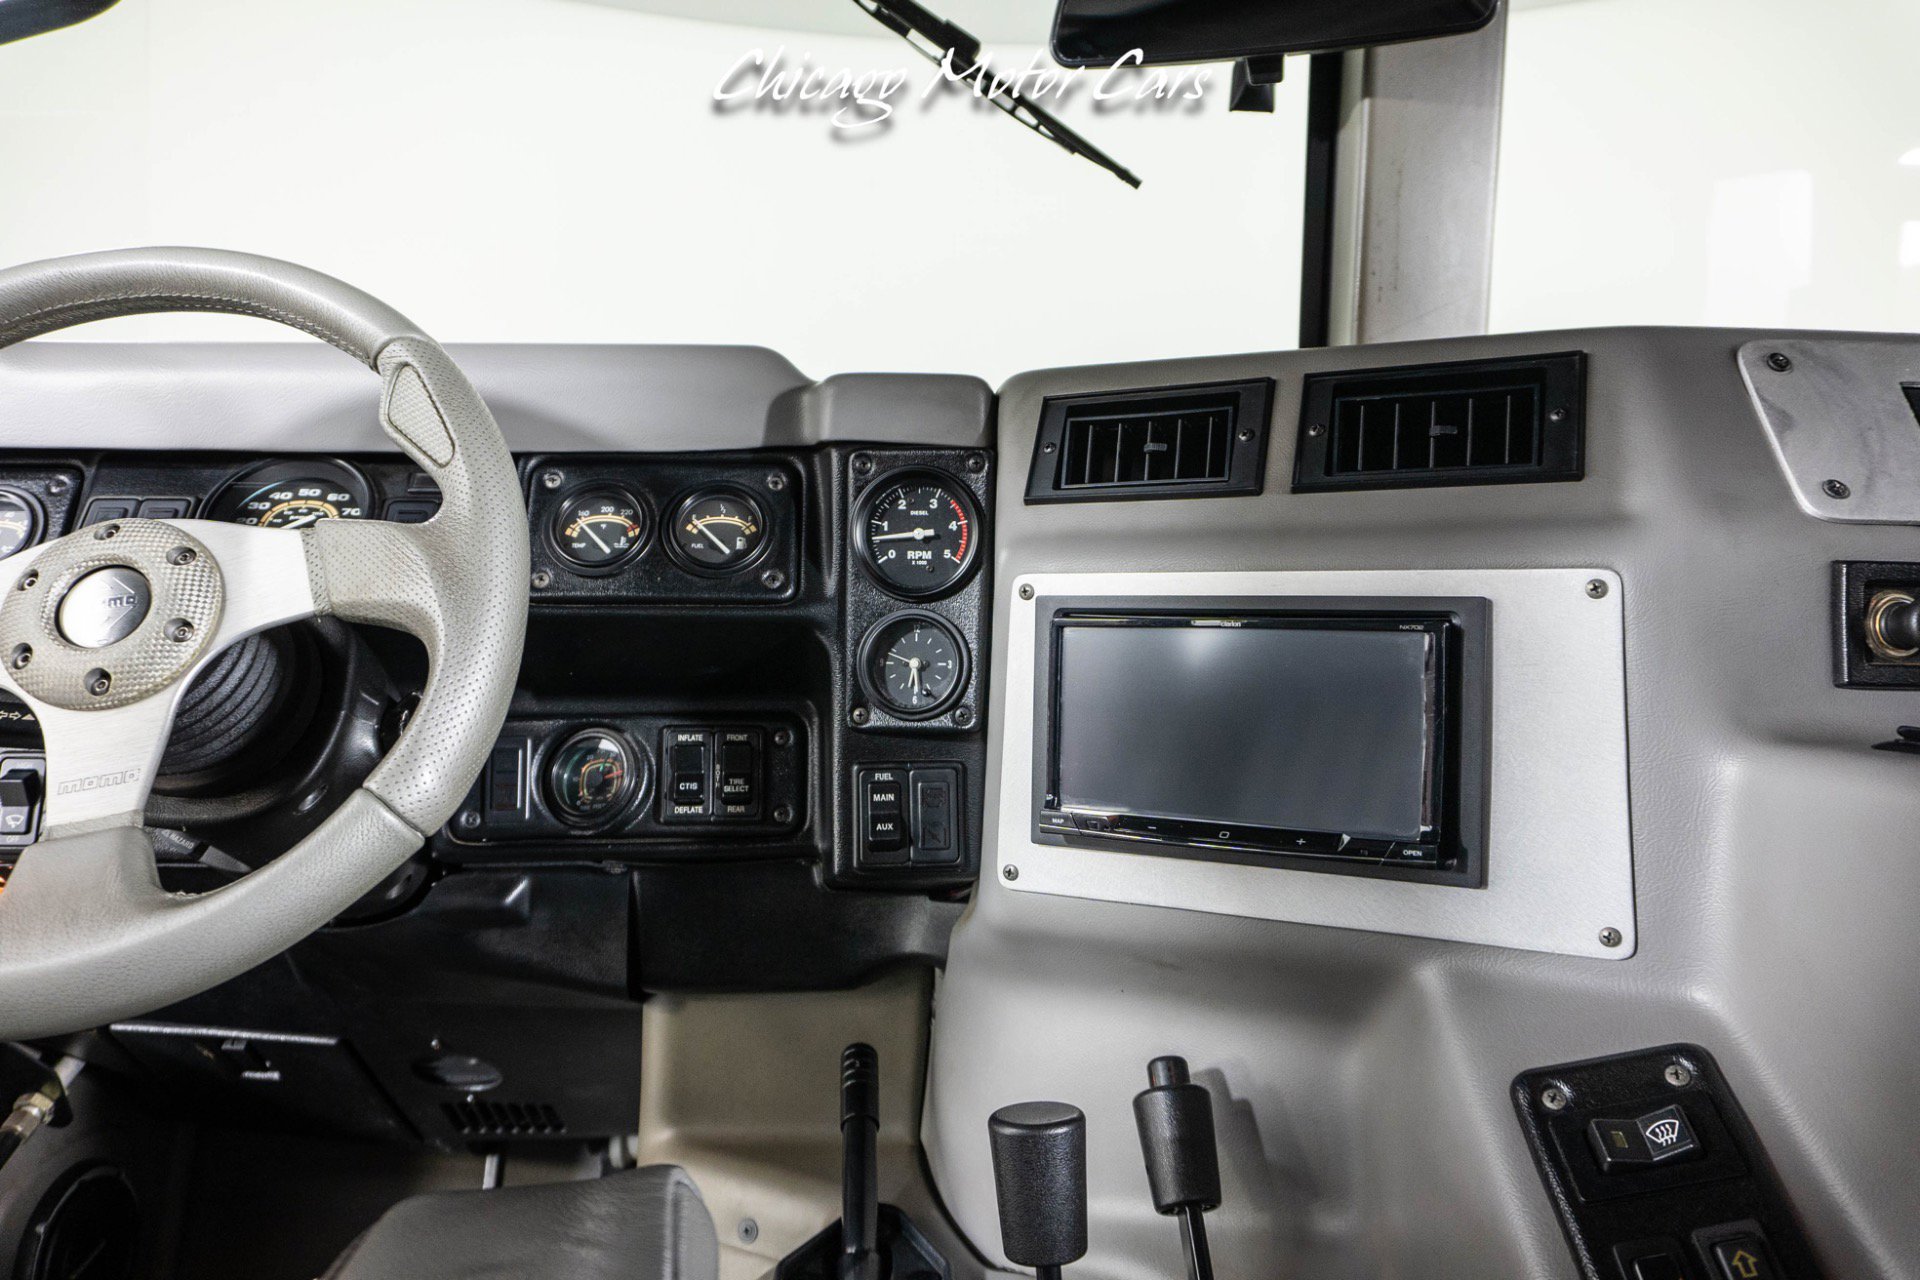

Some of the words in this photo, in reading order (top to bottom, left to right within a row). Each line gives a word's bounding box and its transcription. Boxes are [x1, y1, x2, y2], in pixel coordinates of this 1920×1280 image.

[269, 491, 293, 500] 40
[327, 493, 350, 501] 60
[248, 501, 271, 510] 30
[898, 500, 906, 510] 2
[929, 498, 938, 509] 3
[341, 508, 360, 516] 70
[882, 521, 888, 531] 1
[948, 520, 957, 531] 4
[888, 549, 896, 559] 0
[906, 550, 932, 560] RPM
[943, 549, 951, 559] 5
[947, 659, 952, 669] 3
[912, 695, 918, 704] 6
[679, 782, 698, 790] CTIS
[873, 793, 894, 801] MAIN
[674, 806, 703, 814] DEFLATE
[876, 823, 894, 831] AUX
[169, 833, 195, 850] HAZARD
[1403, 849, 1423, 857] OPEN
